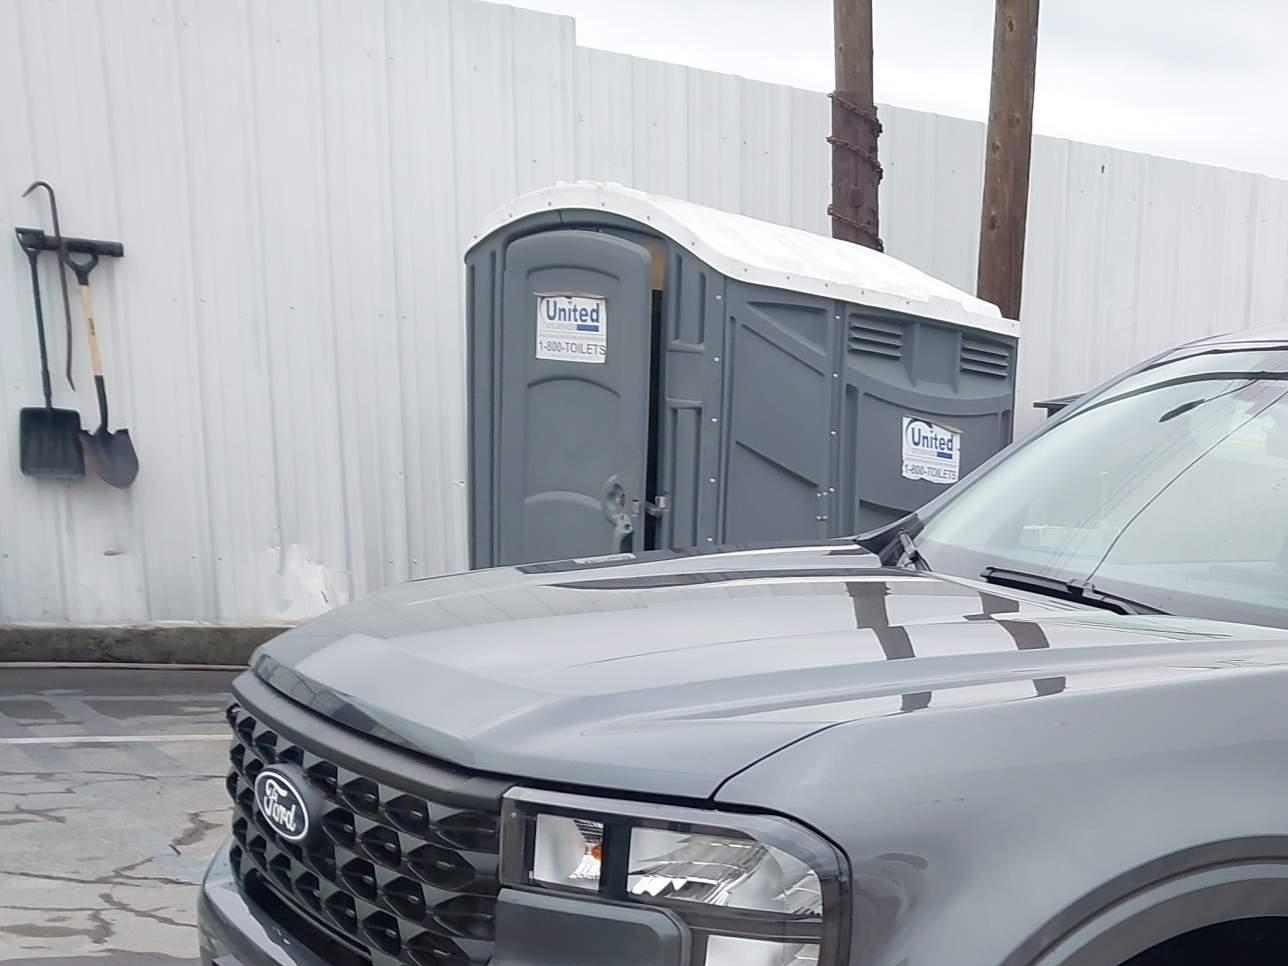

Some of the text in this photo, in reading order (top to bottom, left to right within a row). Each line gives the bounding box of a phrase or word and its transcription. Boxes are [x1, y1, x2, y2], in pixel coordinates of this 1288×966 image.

[545, 299, 600, 323] United
[538, 340, 607, 356] 1-800-TOILETS
[911, 427, 954, 452] United
[904, 463, 958, 480] 1-800-TOILETS
[263, 778, 297, 832] Ford
